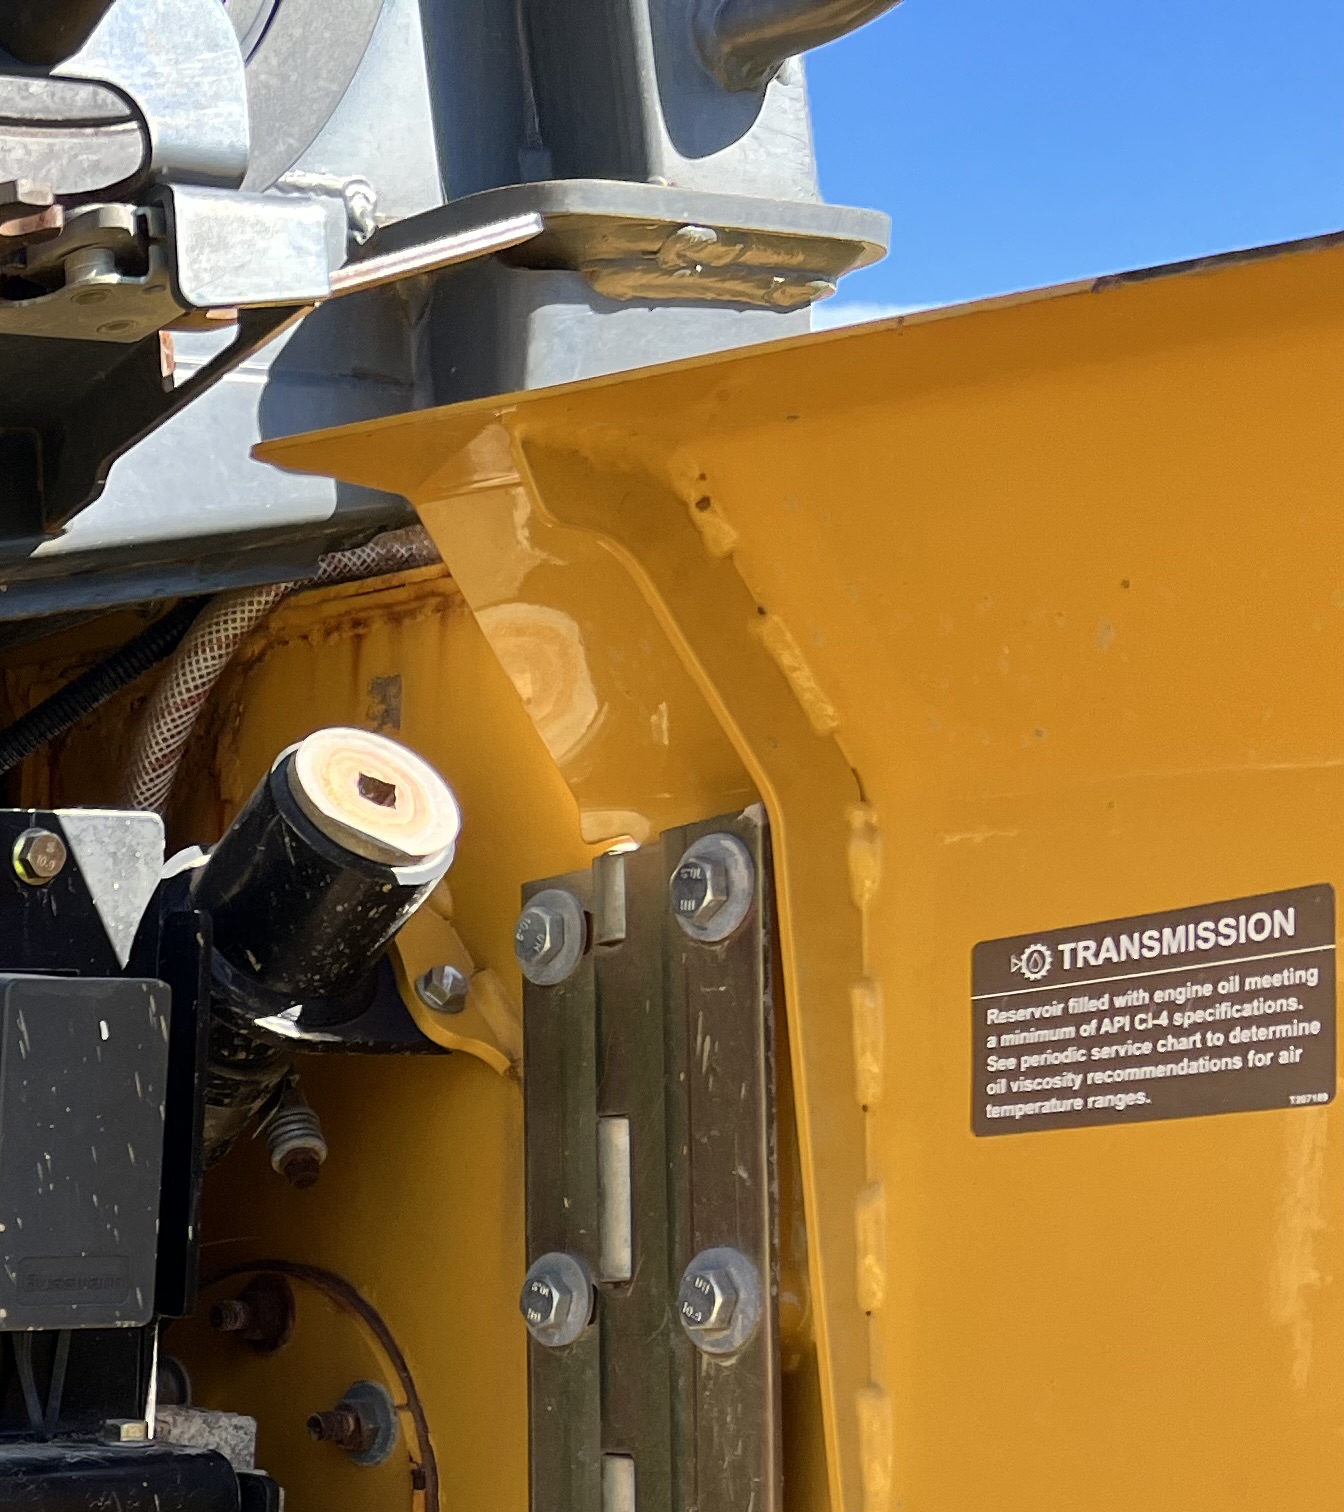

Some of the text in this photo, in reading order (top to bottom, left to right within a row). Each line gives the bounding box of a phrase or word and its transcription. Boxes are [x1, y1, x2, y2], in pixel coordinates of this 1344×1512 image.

[1057, 907, 1296, 969] TRANSMISSION
[986, 968, 1319, 1025] Reservoir filled with engine oil meeting
[986, 997, 1304, 1048] a minimum of API CI-4 specifications.
[986, 1019, 1321, 1072] See periodic service chart to determine
[986, 1046, 1303, 1095] oil viscosity recommendations for air
[985, 1091, 1152, 1119] temperature ranges.
